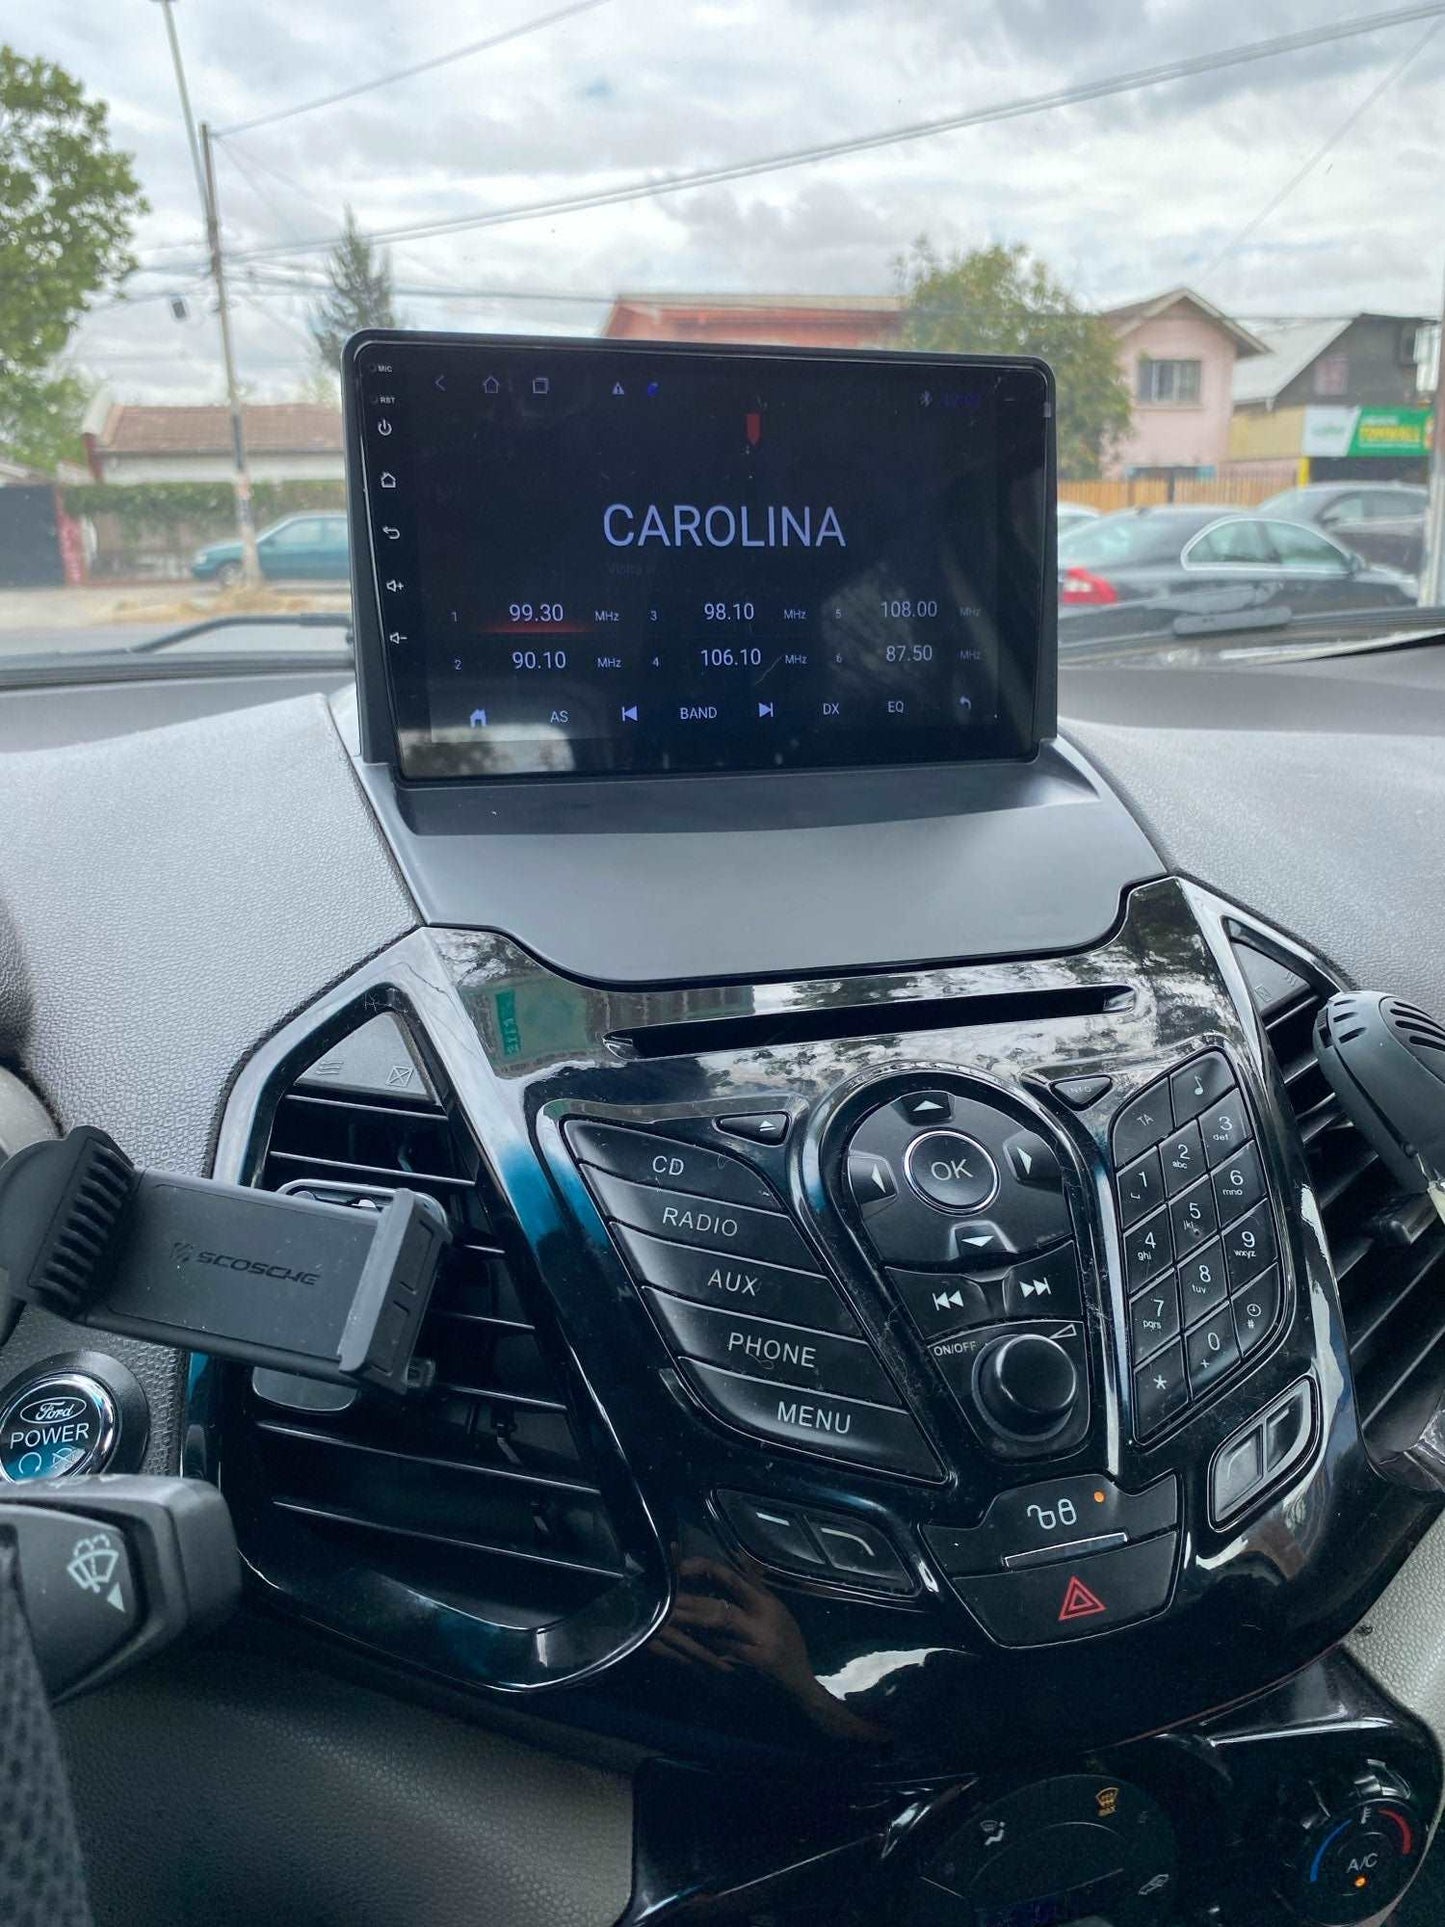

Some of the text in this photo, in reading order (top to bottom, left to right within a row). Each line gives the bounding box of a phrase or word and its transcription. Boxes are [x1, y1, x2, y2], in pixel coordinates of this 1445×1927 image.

[378, 365, 393, 373] MIC
[603, 503, 846, 548] CAROLINA
[451, 603, 620, 622] 1 99.30 MHz
[650, 602, 807, 621] 3 98.10 MHz
[881, 601, 938, 619] 108.00
[454, 651, 622, 671] 2 90.10 MHz
[652, 649, 808, 667] 4 106.10 MHz
[886, 645, 933, 662] 87.50
[680, 706, 718, 720] BAND
[823, 703, 840, 716] DX
[888, 701, 904, 714] EQ
[550, 710, 569, 723] AS
[1137, 1114, 1154, 1127] TA
[1219, 1116, 1233, 1131] 3
[1178, 1145, 1191, 1160] 2
[652, 1155, 684, 1177] CD
[931, 1158, 974, 1181] OK
[1172, 1160, 1188, 1169] abc
[1138, 1171, 1148, 1188] 1
[1229, 1170, 1244, 1186] 6
[1222, 1188, 1243, 1196] mno
[1189, 1202, 1201, 1219] 5
[662, 1207, 738, 1237] RADIO
[1144, 1232, 1157, 1249] 4
[1241, 1231, 1256, 1248] 9
[1138, 1251, 1152, 1260] ghi
[1234, 1250, 1257, 1258] wxyz
[197, 1250, 321, 1286] SCOSCHE
[1199, 1264, 1212, 1283] 8
[708, 1268, 758, 1296] AUX
[1192, 1284, 1207, 1294] tuv
[1153, 1299, 1165, 1317] 7
[1142, 1319, 1162, 1330] pqrs
[728, 1332, 816, 1368] PHONE
[933, 1341, 977, 1357] ON/OFF
[1207, 1332, 1221, 1351] 0
[35, 1401, 75, 1421] Ford
[777, 1401, 851, 1434] MENU
[10, 1422, 90, 1450] POWER
[1345, 1852, 1379, 1874] A/C
